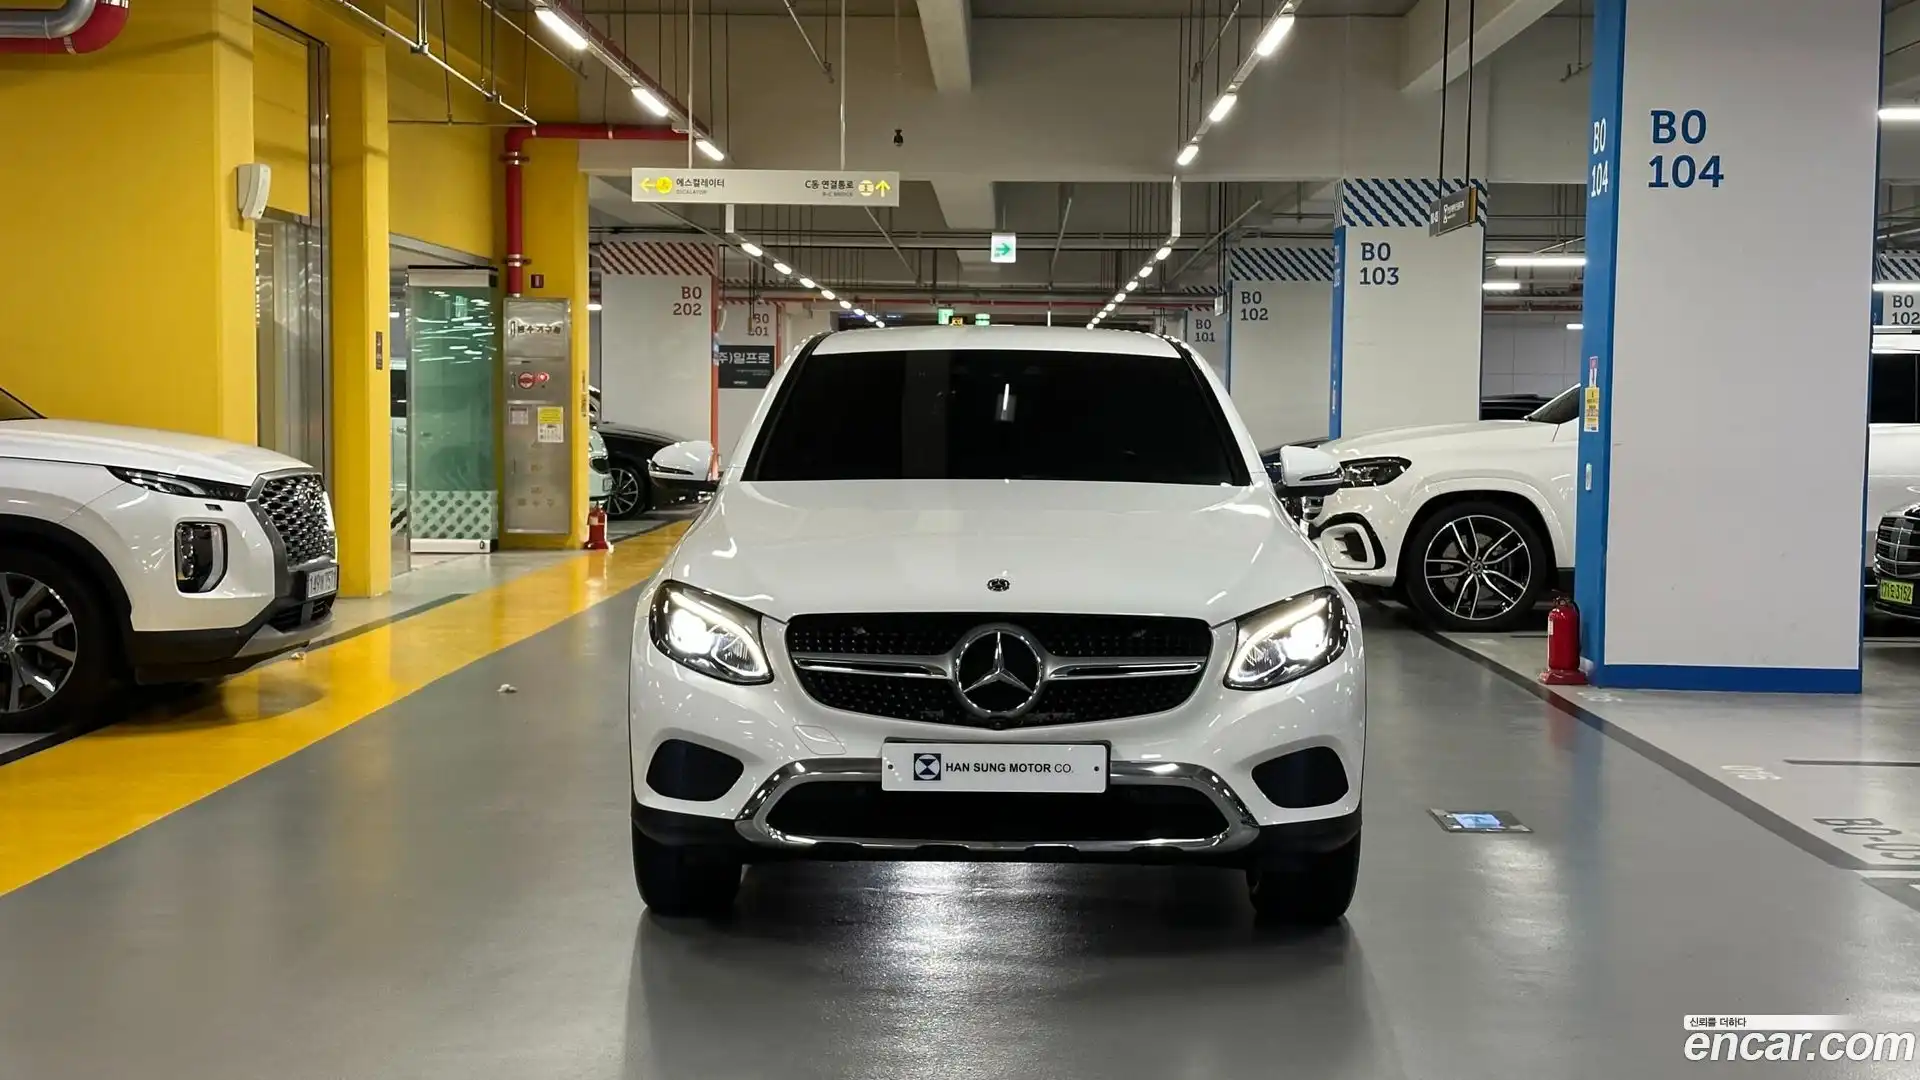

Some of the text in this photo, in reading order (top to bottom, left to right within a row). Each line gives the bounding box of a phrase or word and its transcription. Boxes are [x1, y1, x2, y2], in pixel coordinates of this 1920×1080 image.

[1648, 154, 1725, 188] 104
[676, 178, 725, 188] 에스컬레이터
[804, 179, 819, 190] C동
[1590, 159, 1609, 198] 104
[1359, 267, 1399, 286] 103
[673, 303, 702, 316] 202
[1240, 308, 1269, 321] 102
[1891, 312, 1920, 325] 102
[1195, 332, 1215, 342] 101
[945, 763, 970, 772] HAN
[973, 763, 1006, 773] SUNG
[1009, 763, 1051, 773] MOTOR
